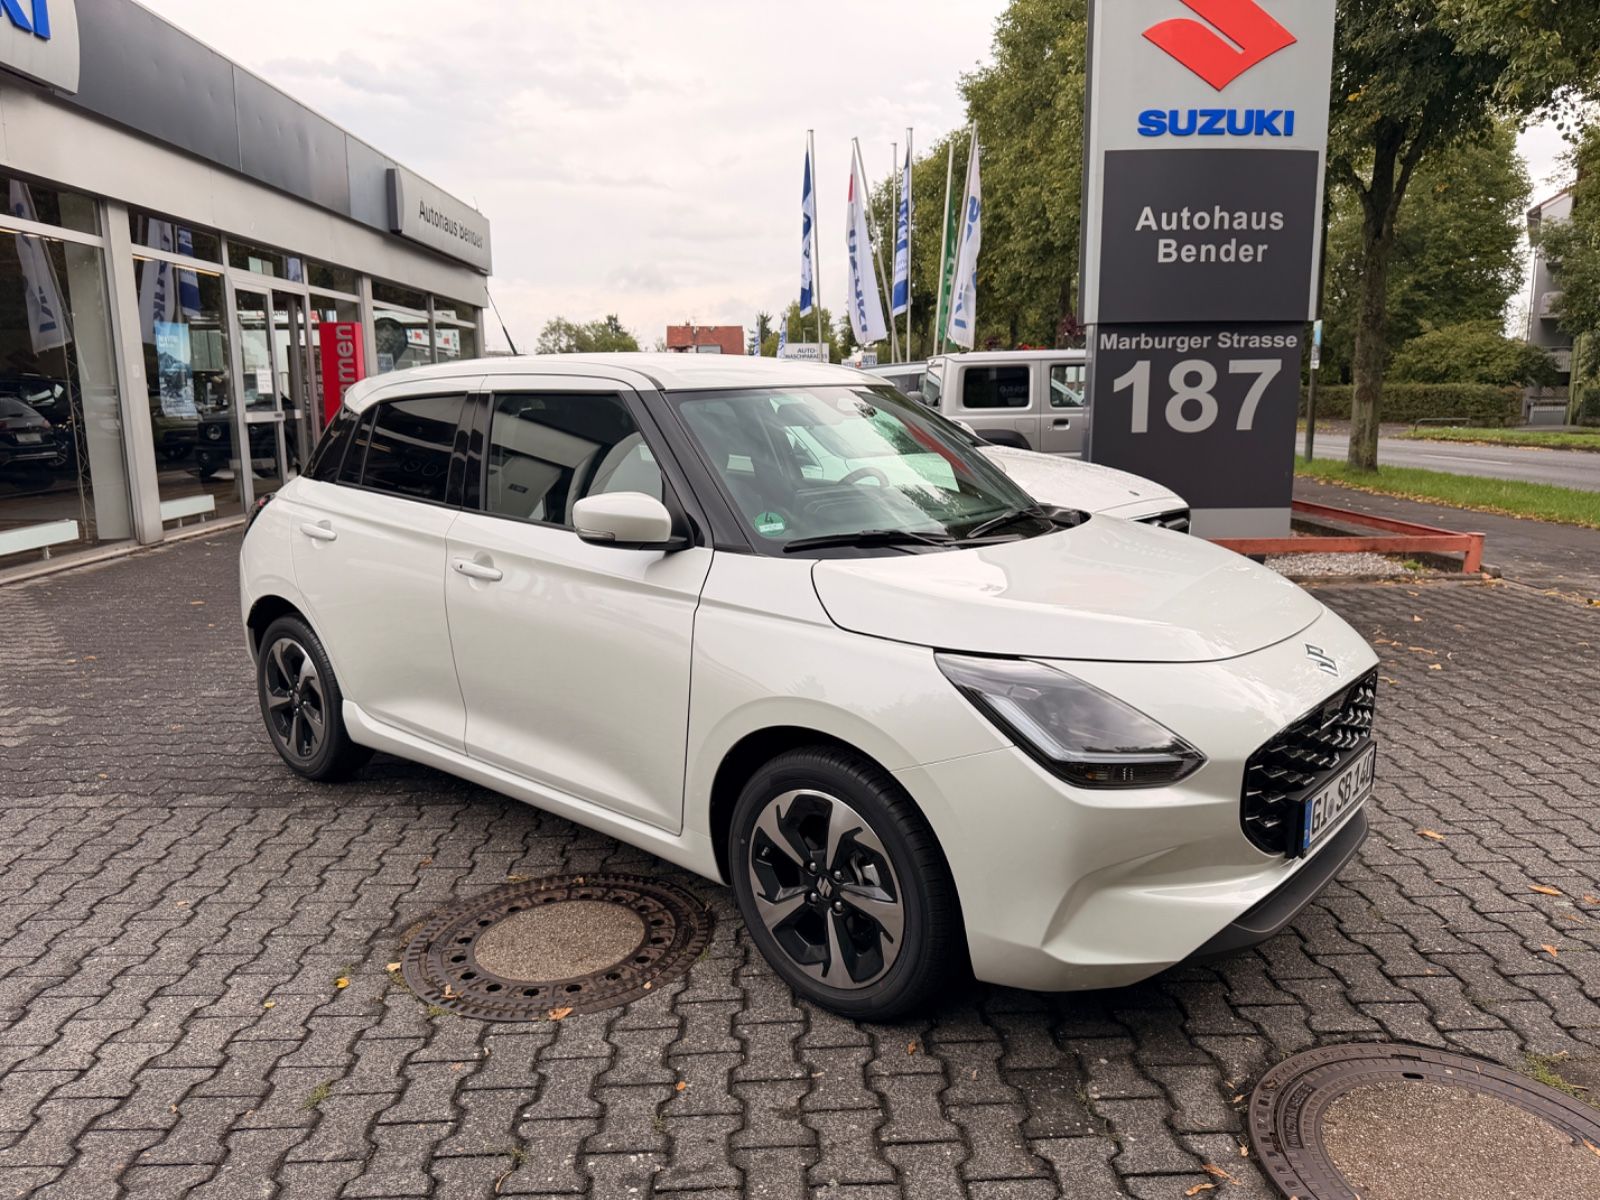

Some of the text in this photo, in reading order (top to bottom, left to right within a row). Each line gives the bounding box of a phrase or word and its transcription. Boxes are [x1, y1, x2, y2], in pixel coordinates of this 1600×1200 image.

[1137, 108, 1295, 137] SUZUKI
[419, 199, 458, 237] Autohaus
[1135, 205, 1284, 232] Autohaus
[1157, 237, 1269, 263] Bender
[1100, 331, 1298, 352] Marburger Strasse
[1112, 358, 1283, 434] 187
[764, 512, 774, 524] 4
[1311, 791, 1329, 836] GI
[1335, 770, 1352, 812] SB
